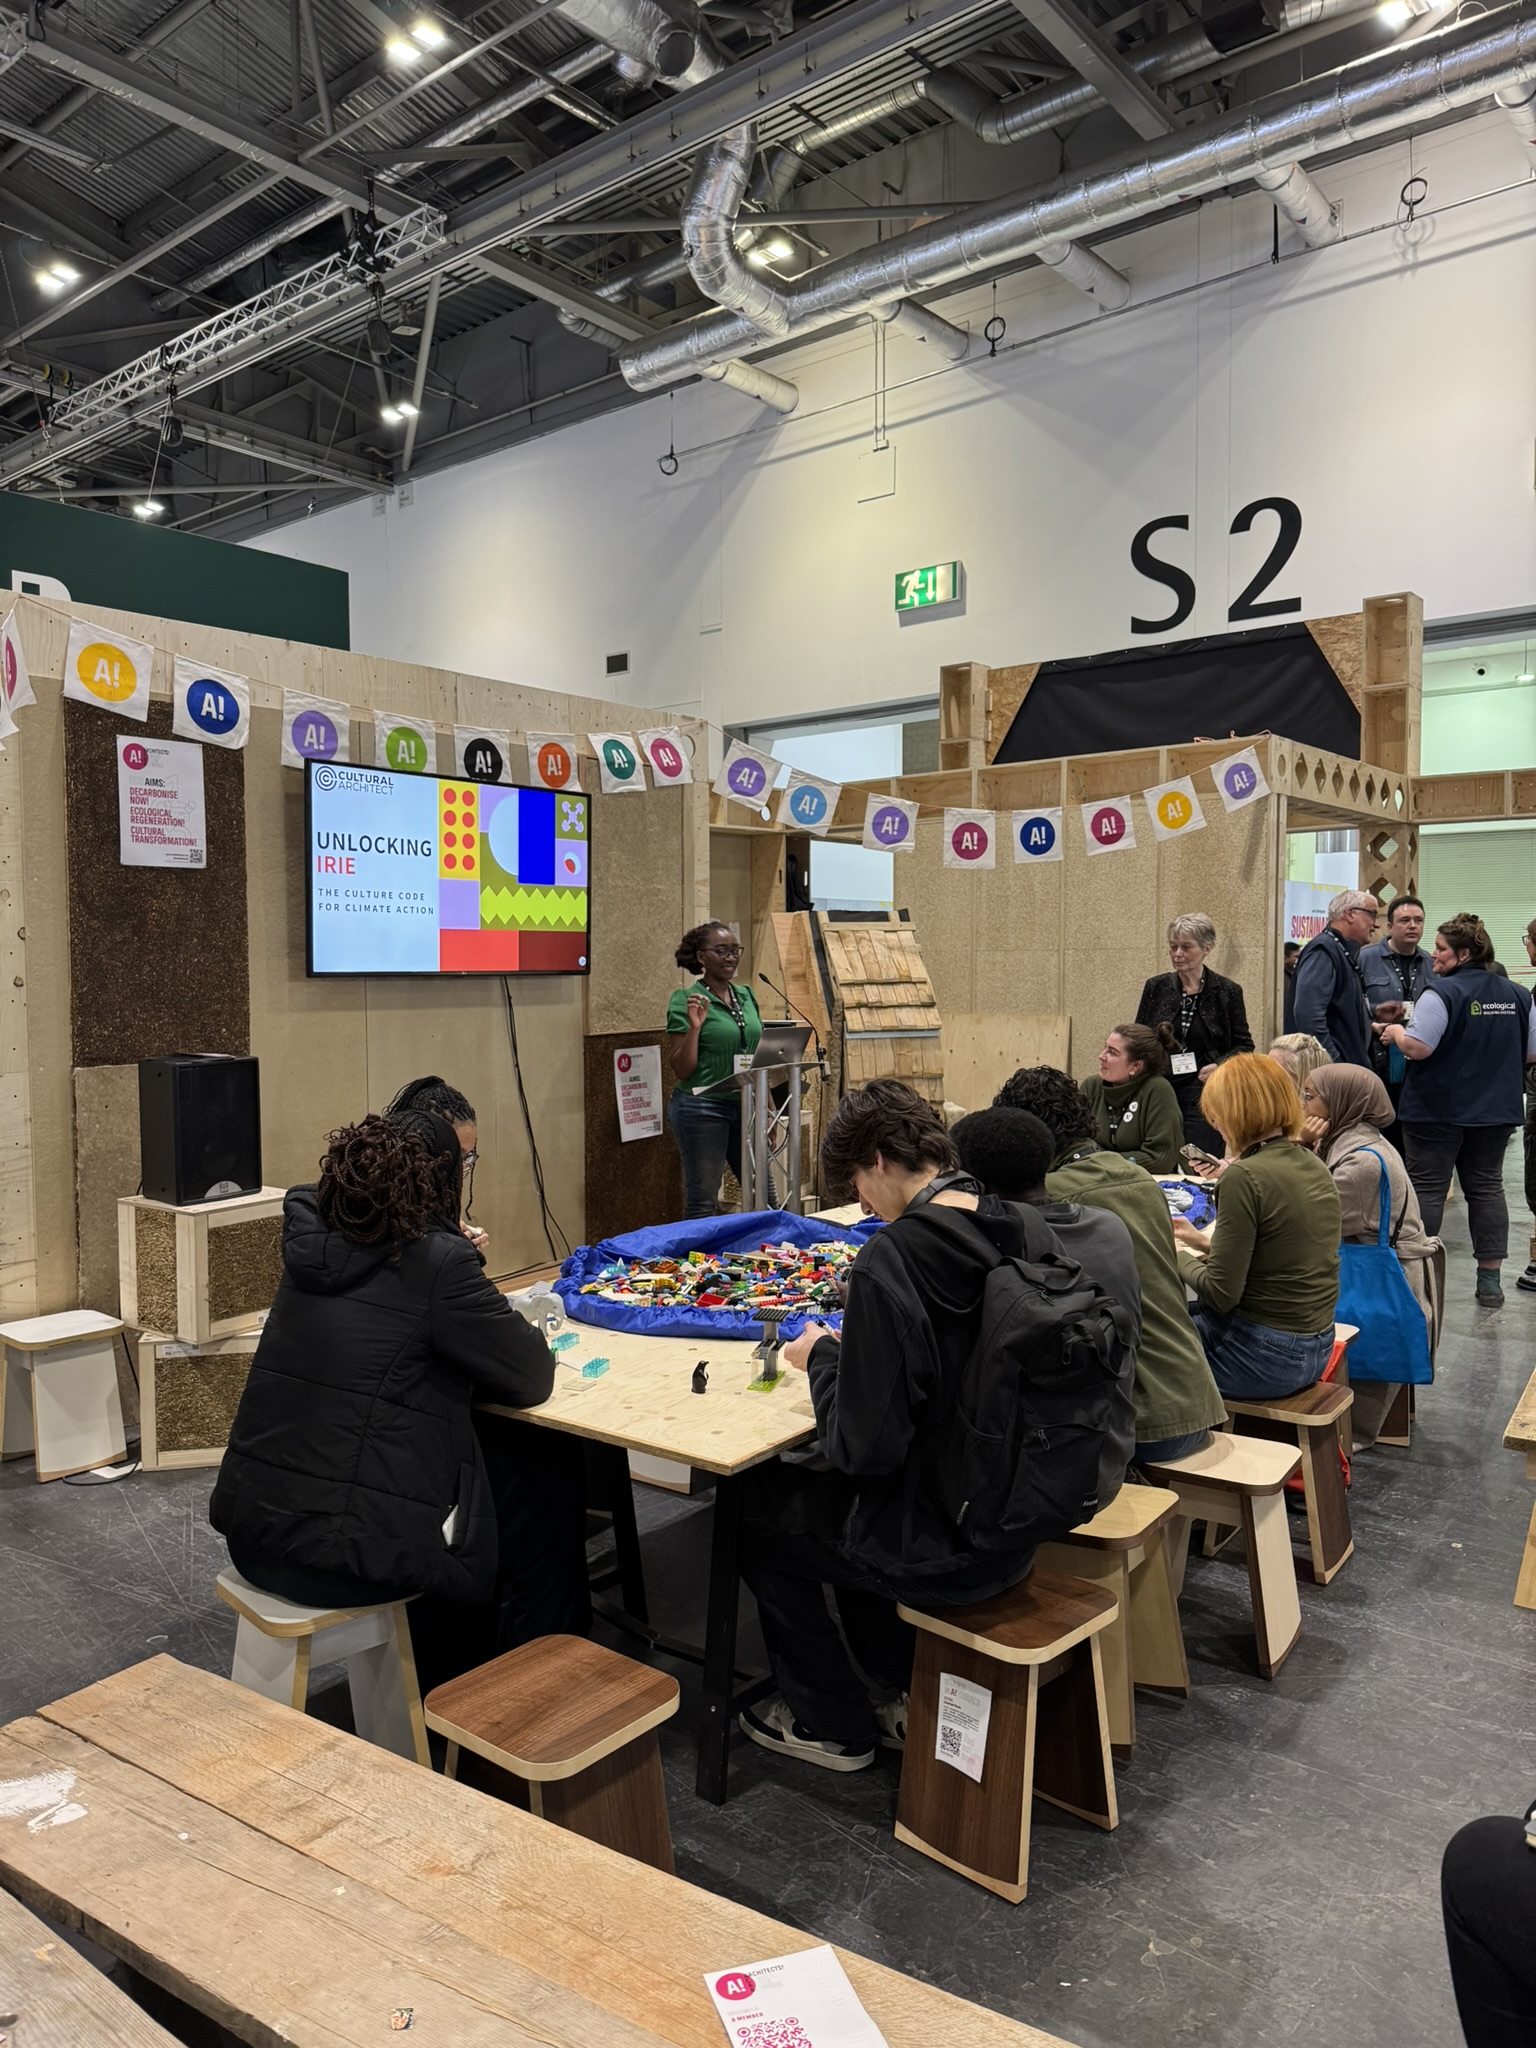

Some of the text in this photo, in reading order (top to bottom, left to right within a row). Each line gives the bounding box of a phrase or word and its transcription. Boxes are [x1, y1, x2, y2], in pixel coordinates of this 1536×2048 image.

[94, 658, 120, 689] A!
[200, 692, 225, 722] A!
[303, 723, 326, 751] A!
[129, 749, 142, 764] A!
[397, 739, 416, 764] A!
[474, 749, 493, 774] A!
[613, 748, 629, 768] A!
[661, 747, 677, 767] A!
[547, 754, 563, 777] A!
[145, 777, 166, 788] AIMS:
[338, 771, 394, 786] CULTURAL
[736, 766, 759, 789] A!
[1232, 769, 1251, 790] A!
[129, 787, 178, 799] DECARBONISE
[338, 781, 394, 795] ARCHITECT
[130, 796, 150, 806] NOW!
[797, 794, 818, 817] A!
[1166, 800, 1185, 820] A!
[130, 807, 172, 818] ECOLOGICAL
[130, 816, 185, 827] REGENERATION!
[130, 826, 165, 836] CULTURAL
[881, 815, 901, 836] A!
[1100, 816, 1116, 836] A!
[131, 835, 197, 847] TRANSFORMATION!
[317, 831, 432, 857] UNLOCKING
[961, 831, 978, 850] A!
[1029, 826, 1047, 846] A!
[317, 855, 356, 875] IRIE
[318, 888, 425, 901] THE CULTURE CODE
[318, 902, 434, 915] FOR CLIMATE ACTION
[1291, 915, 1329, 938] SUSTAINA
[1482, 1002, 1516, 1010] ecological
[726, 1978, 747, 1995] A!
[737, 2012, 764, 2021] MEMBER
